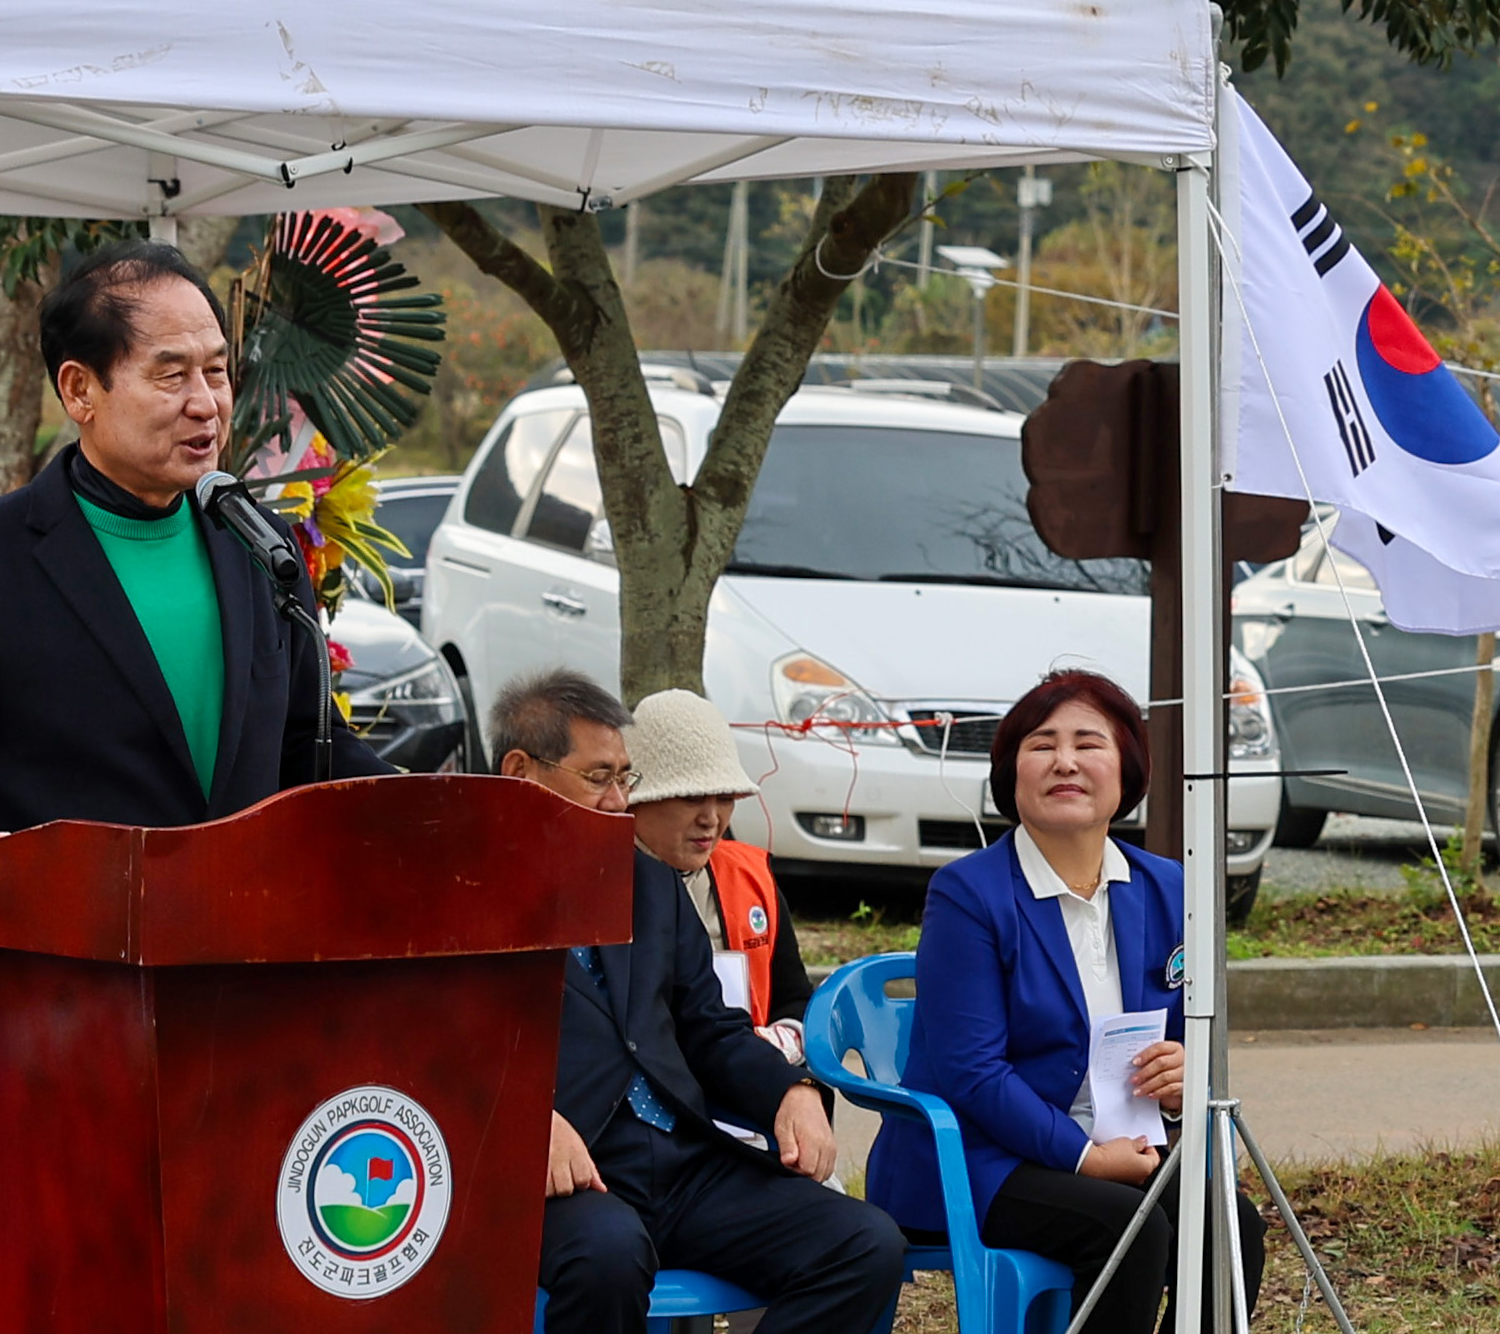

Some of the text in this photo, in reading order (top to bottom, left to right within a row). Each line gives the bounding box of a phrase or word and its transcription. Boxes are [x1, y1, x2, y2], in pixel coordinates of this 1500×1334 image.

[287, 1119, 329, 1194] JINDOGUN
[393, 1104, 444, 1187] ASSOCIATION
[297, 1227, 431, 1287] 진도군파크골프협회
